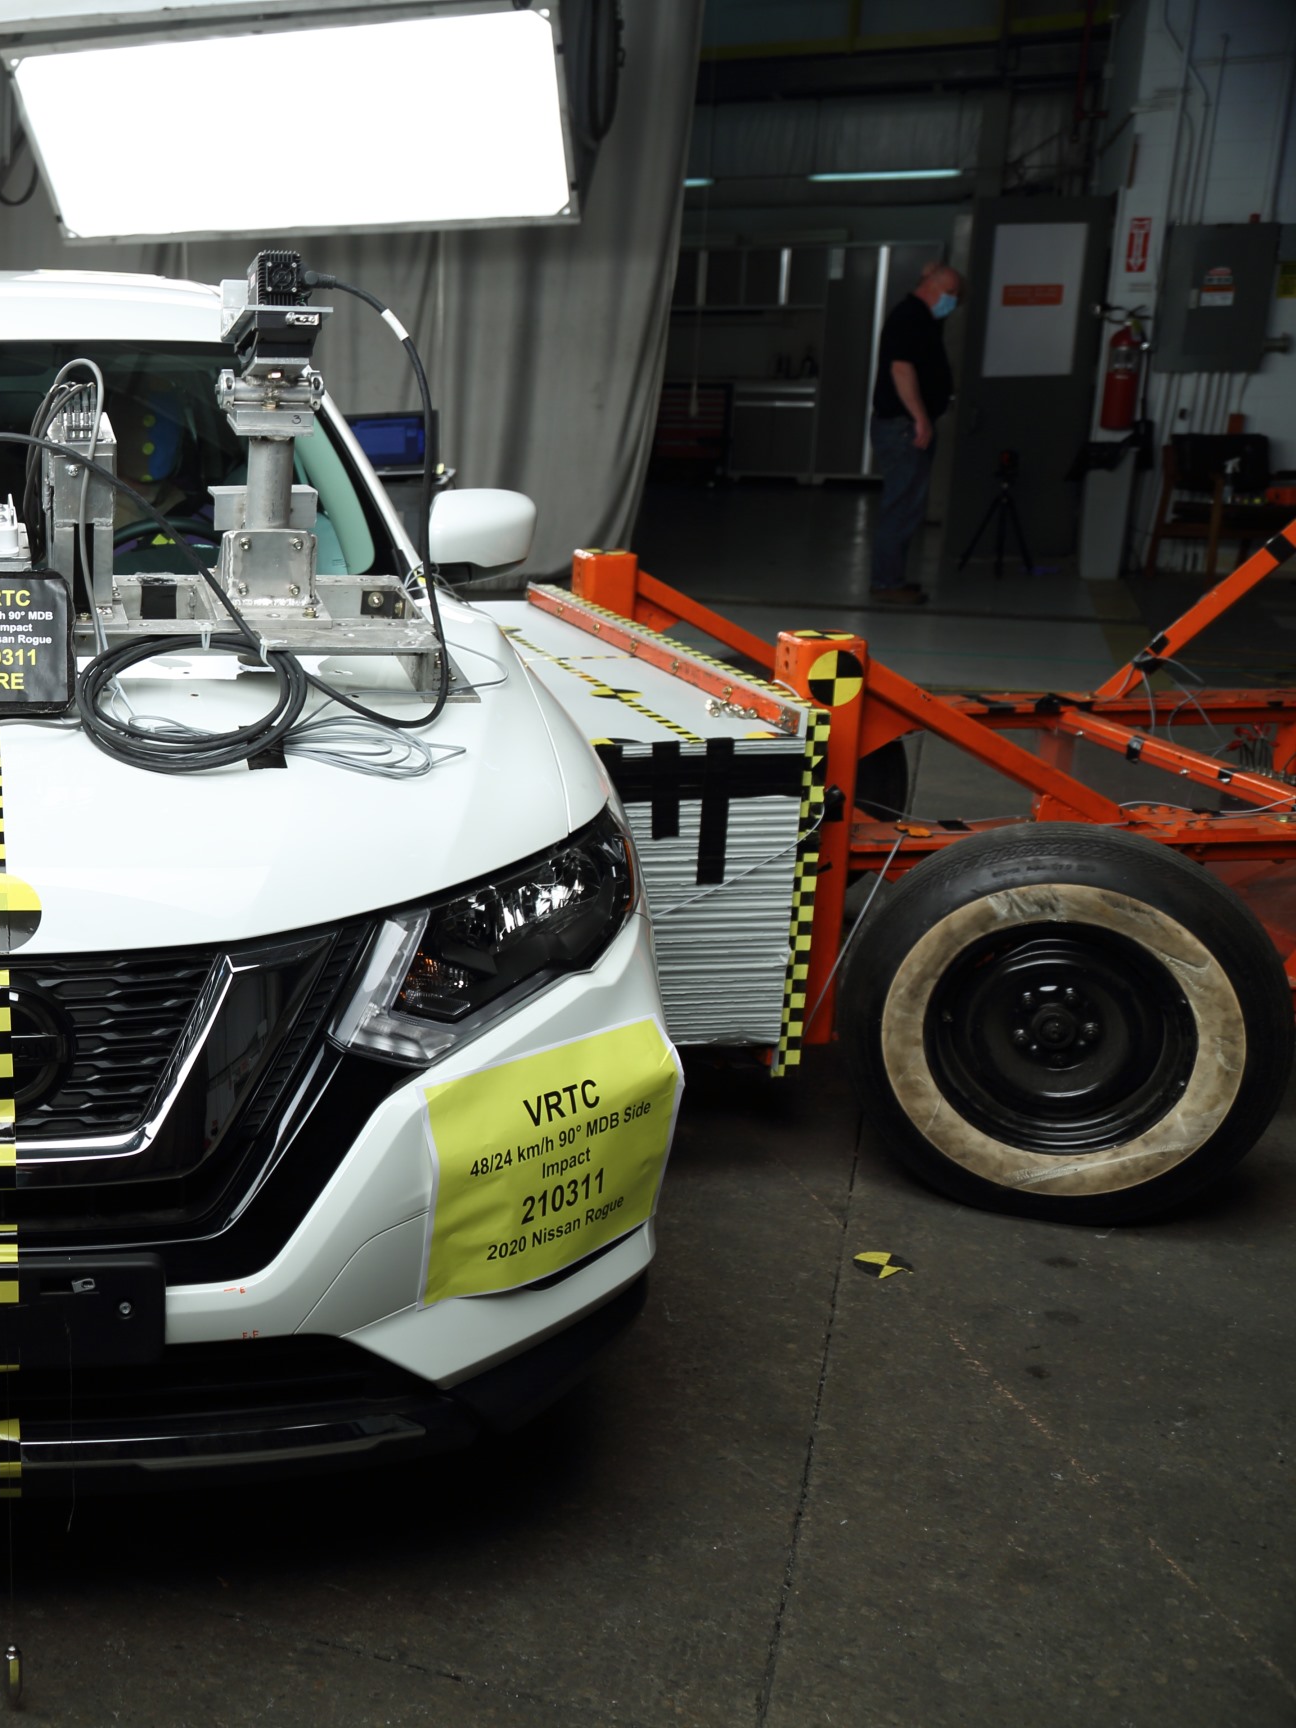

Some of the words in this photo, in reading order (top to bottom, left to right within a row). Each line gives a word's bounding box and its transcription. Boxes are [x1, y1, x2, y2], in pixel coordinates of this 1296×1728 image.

[291, 414, 302, 425] 3
[8, 611, 26, 620] 90°
[28, 611, 53, 620] MDB
[18, 634, 52, 646] Rogue
[522, 1079, 600, 1127] VRTC
[470, 1148, 513, 1177] 48/24
[517, 1136, 554, 1163] km/h
[558, 1125, 582, 1147] 90°
[586, 1112, 619, 1138] MDB
[623, 1100, 651, 1123] Side
[542, 1147, 591, 1179] Impact
[521, 1167, 605, 1225] 210311
[486, 1236, 527, 1261] 2020
[532, 1218, 580, 1248] Nissan
[585, 1196, 624, 1225] Rogue
